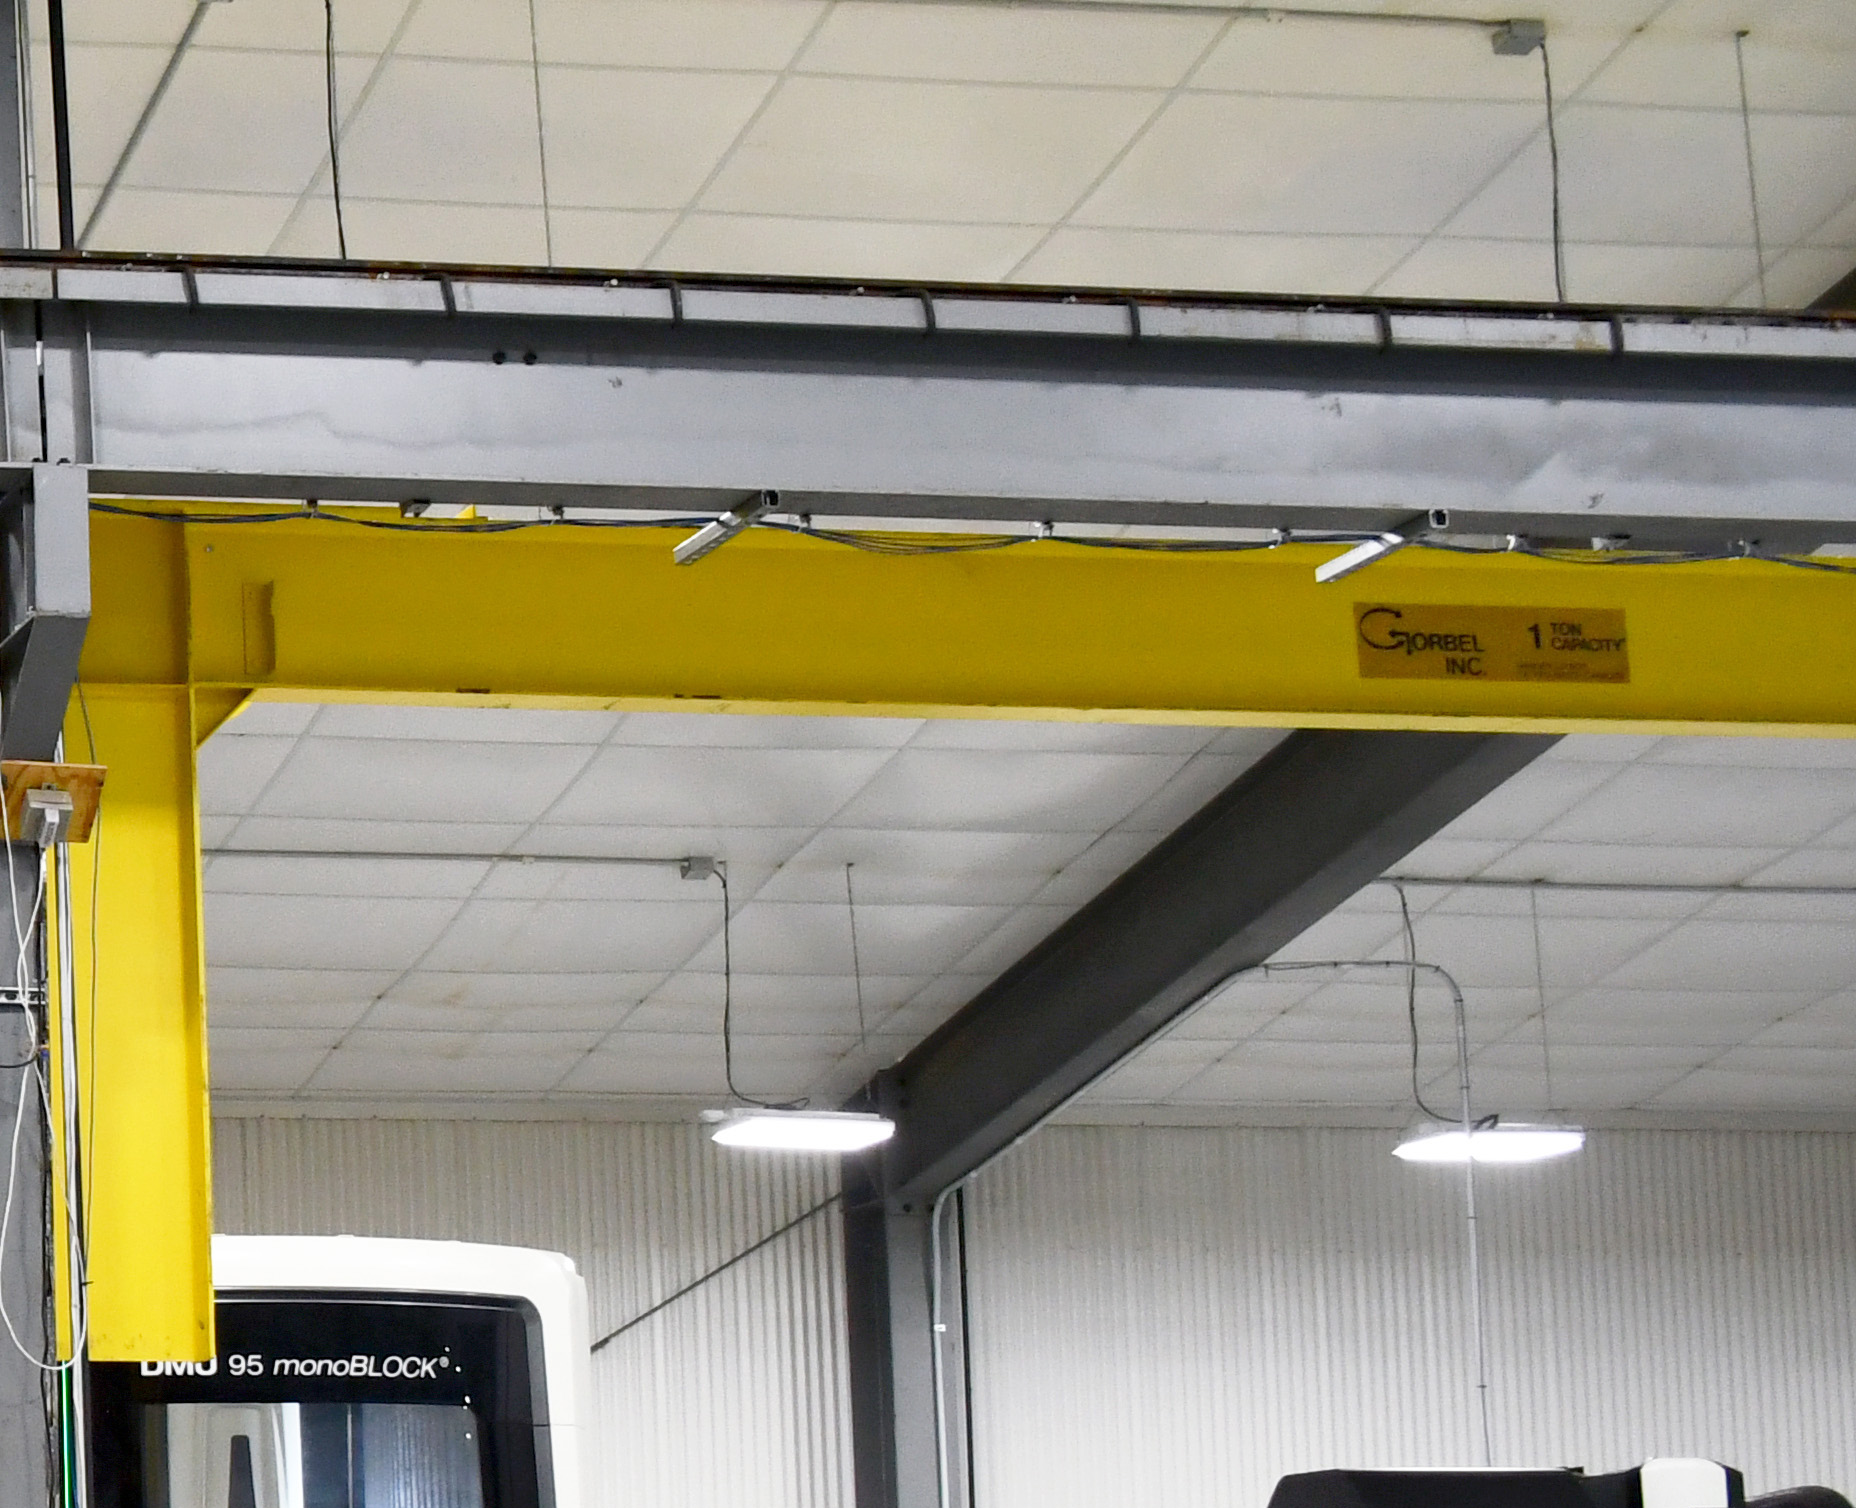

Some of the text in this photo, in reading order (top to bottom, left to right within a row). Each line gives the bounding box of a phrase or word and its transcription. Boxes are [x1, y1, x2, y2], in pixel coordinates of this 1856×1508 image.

[1360, 608, 1485, 655] GORBEL
[1528, 622, 1582, 649] 1 TON
[1551, 637, 1626, 653] CAPACITY
[228, 1354, 264, 1376] 95
